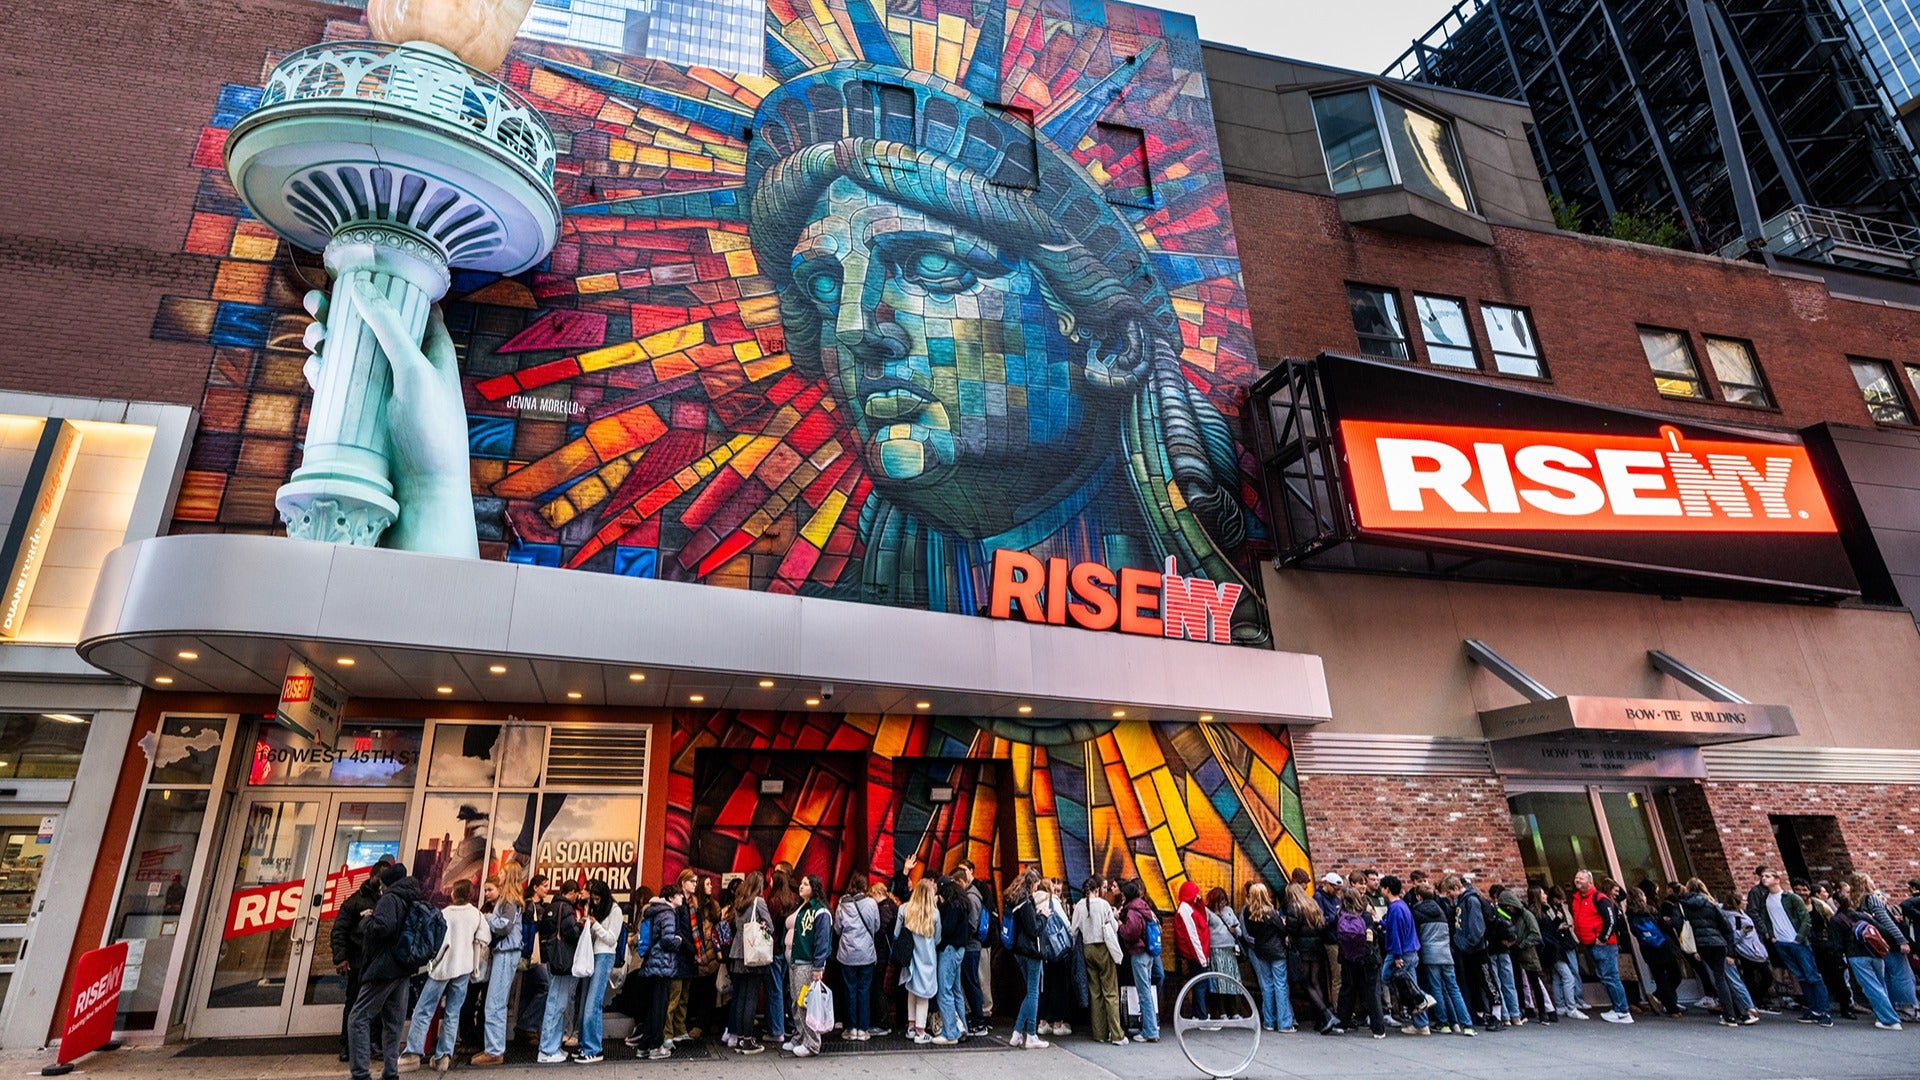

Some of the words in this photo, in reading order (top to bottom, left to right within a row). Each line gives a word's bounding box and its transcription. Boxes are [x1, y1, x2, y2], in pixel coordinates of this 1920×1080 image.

[506, 395, 537, 410] JENNA
[540, 398, 579, 414] MORELLO
[990, 549, 1243, 644] RISENY
[1692, 711, 1746, 724] BUILDING
[258, 749, 289, 763] 160
[292, 749, 348, 763] WEST
[350, 750, 394, 764] 45TH
[399, 750, 420, 764] ST
[539, 841, 552, 863] A
[555, 841, 634, 863] SOARING
[584, 867, 632, 890] YORK
[73, 961, 125, 1018] RISENY
